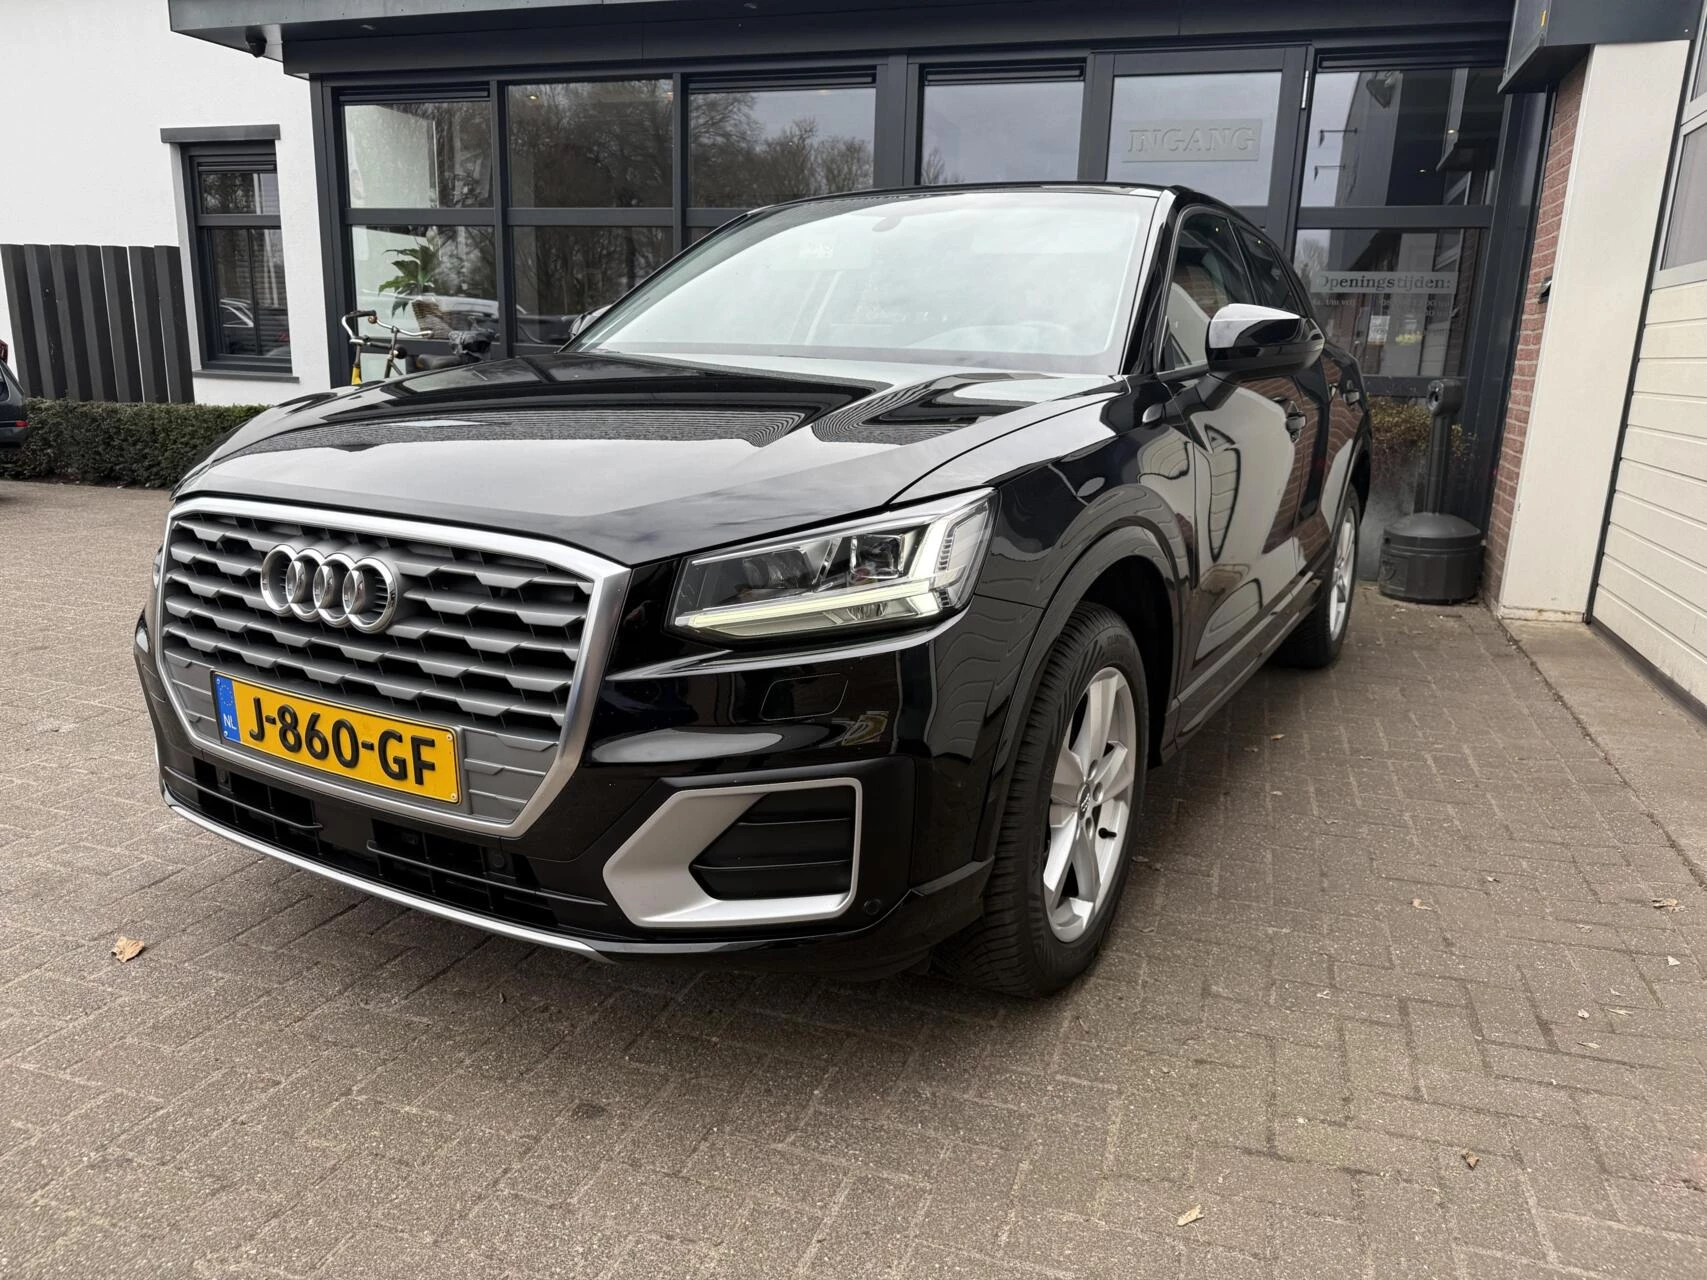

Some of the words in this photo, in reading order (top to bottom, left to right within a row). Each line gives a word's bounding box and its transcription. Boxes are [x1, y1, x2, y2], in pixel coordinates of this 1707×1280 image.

[1127, 127, 1257, 153] INGANG
[223, 713, 238, 731] NL
[248, 696, 436, 786] J-860-GF
